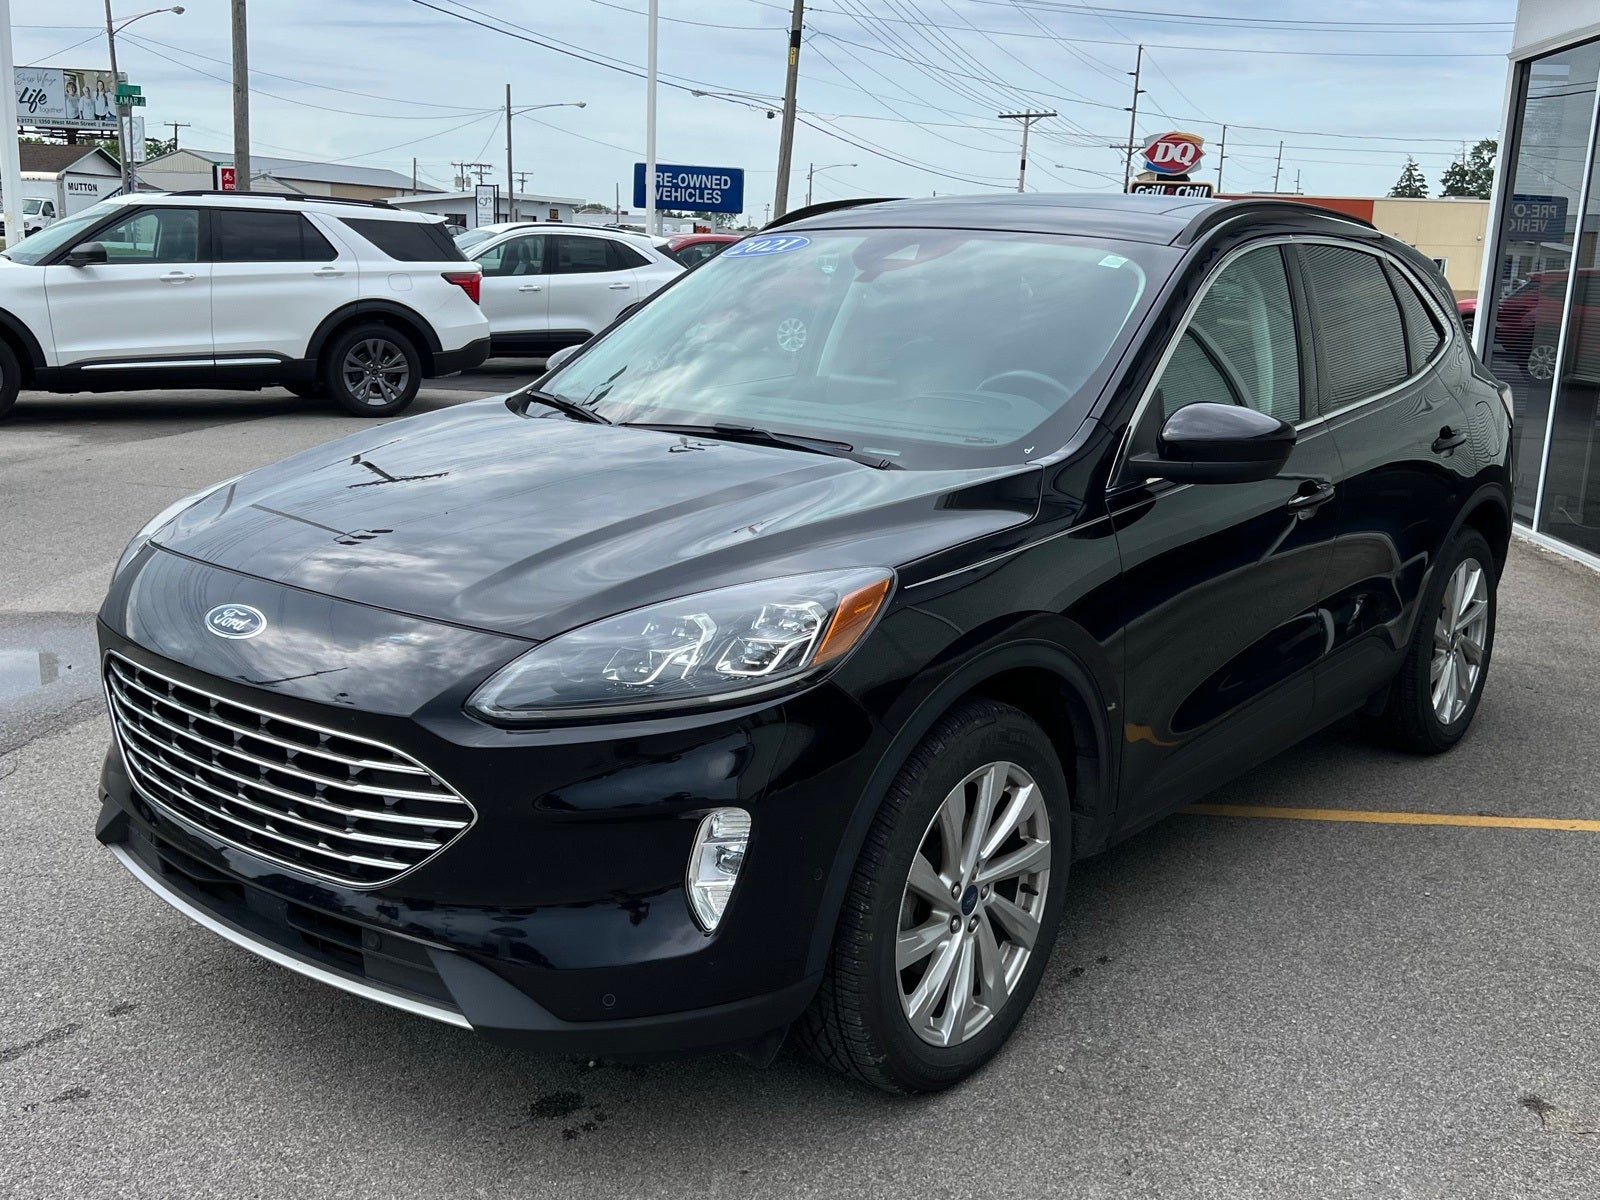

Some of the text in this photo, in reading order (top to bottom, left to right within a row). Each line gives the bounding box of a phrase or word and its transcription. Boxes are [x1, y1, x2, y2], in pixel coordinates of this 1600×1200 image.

[19, 87, 47, 113] Life
[114, 96, 138, 105] LAMAR
[1152, 142, 1196, 166] DQ
[67, 182, 98, 192] MUTTON
[645, 172, 731, 190] RE-OWNED
[1135, 185, 1166, 195] Grill
[1175, 185, 1209, 198] Chill
[727, 238, 803, 256] 2021
[213, 608, 252, 631] Ford
